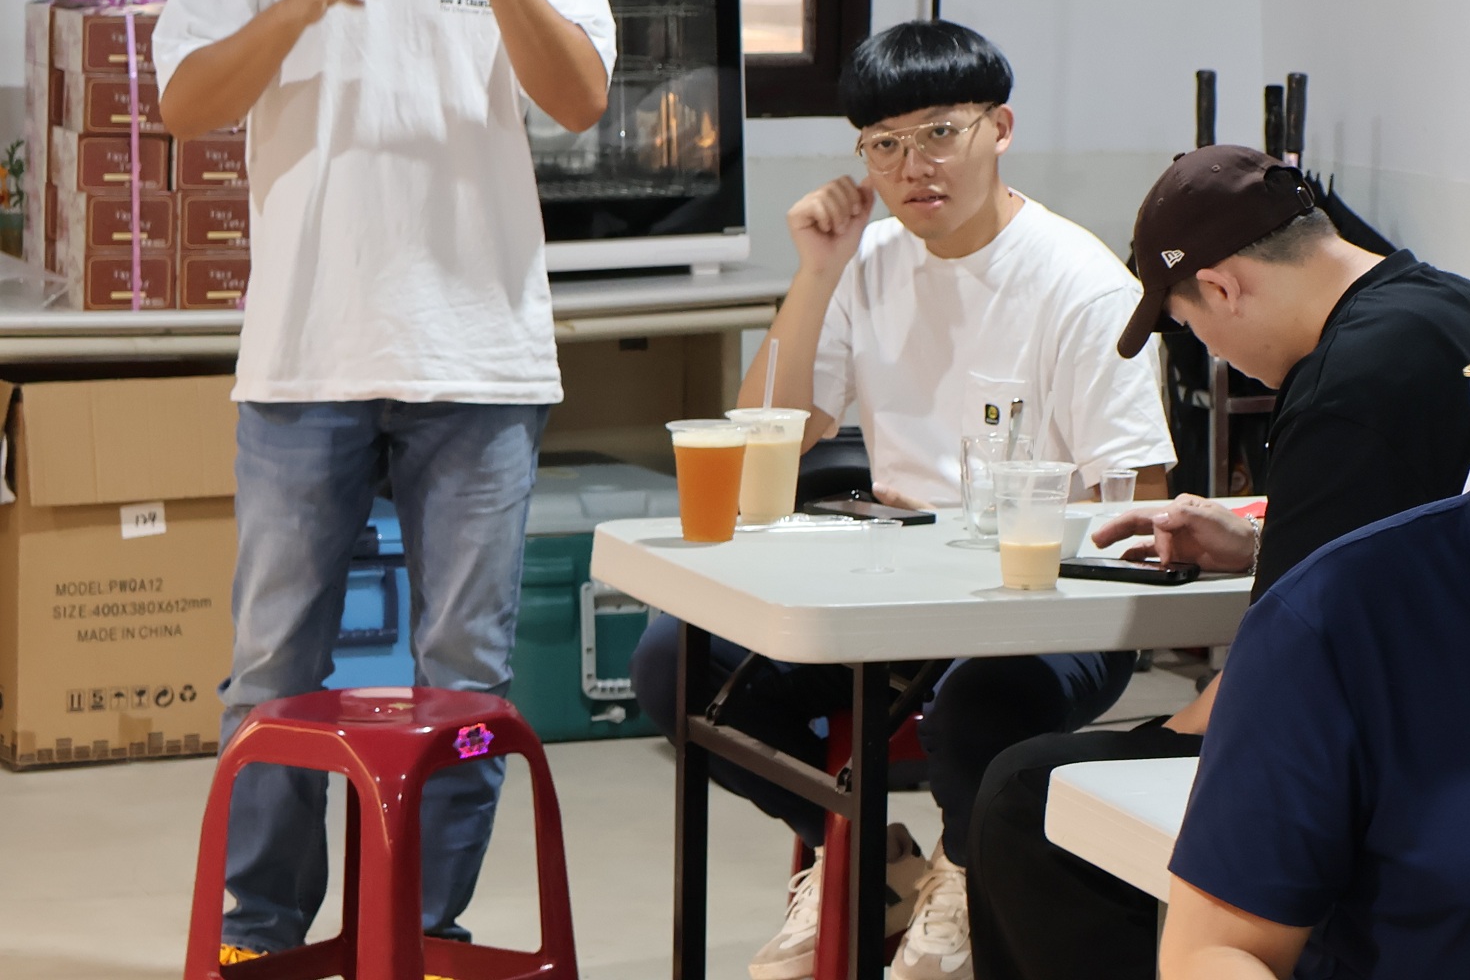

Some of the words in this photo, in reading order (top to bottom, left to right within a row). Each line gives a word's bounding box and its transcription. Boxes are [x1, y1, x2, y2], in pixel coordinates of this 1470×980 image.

[77, 626, 118, 642] MADE
[122, 626, 136, 640] IN
[138, 624, 183, 641] CHINA
